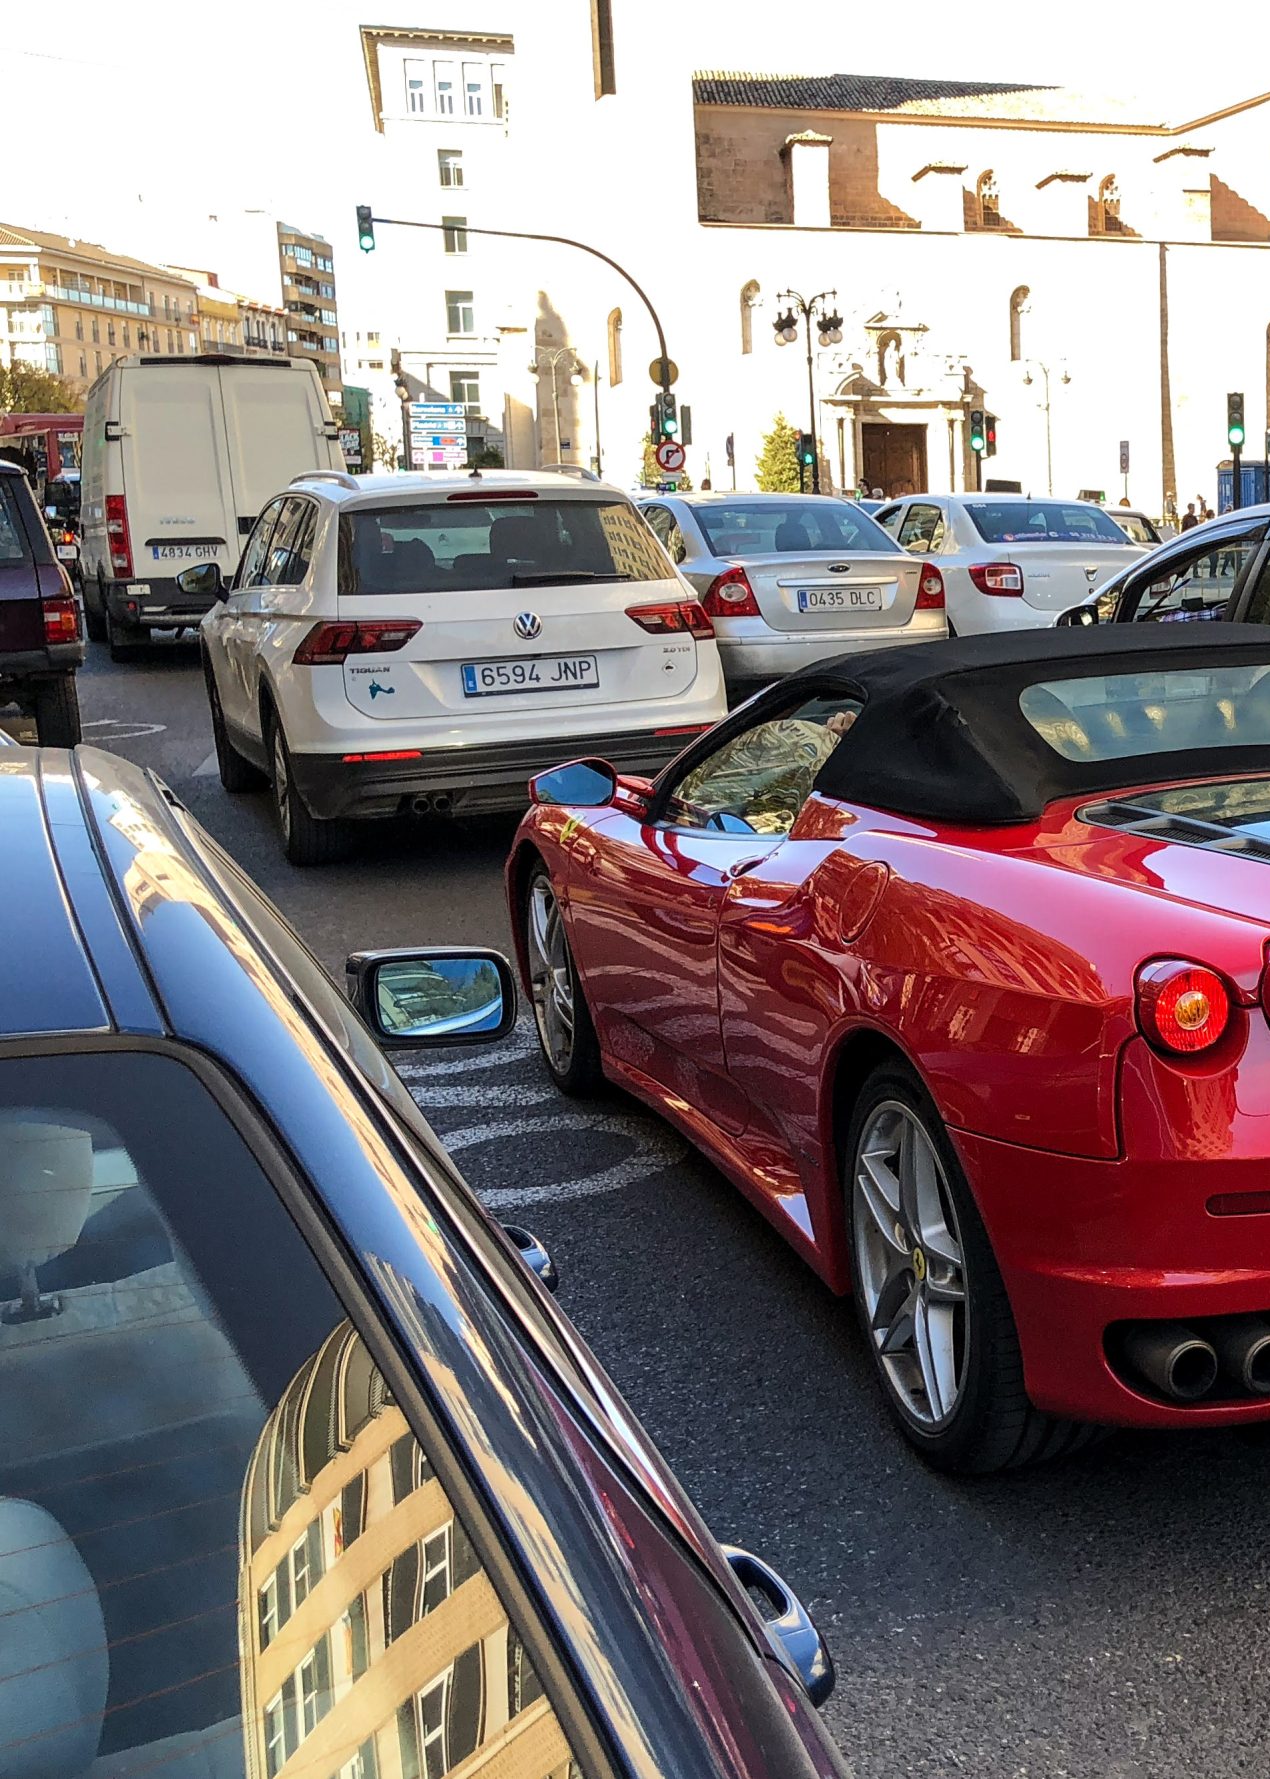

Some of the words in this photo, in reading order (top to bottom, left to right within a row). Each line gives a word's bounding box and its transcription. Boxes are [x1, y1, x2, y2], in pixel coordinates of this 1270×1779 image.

[161, 546, 192, 558] 4834
[195, 545, 218, 557] GHV
[809, 592, 844, 606] 0435
[850, 591, 875, 605] DLC
[349, 666, 390, 674] TIGUAN
[481, 664, 541, 687] 6594
[551, 660, 592, 682] JNP
